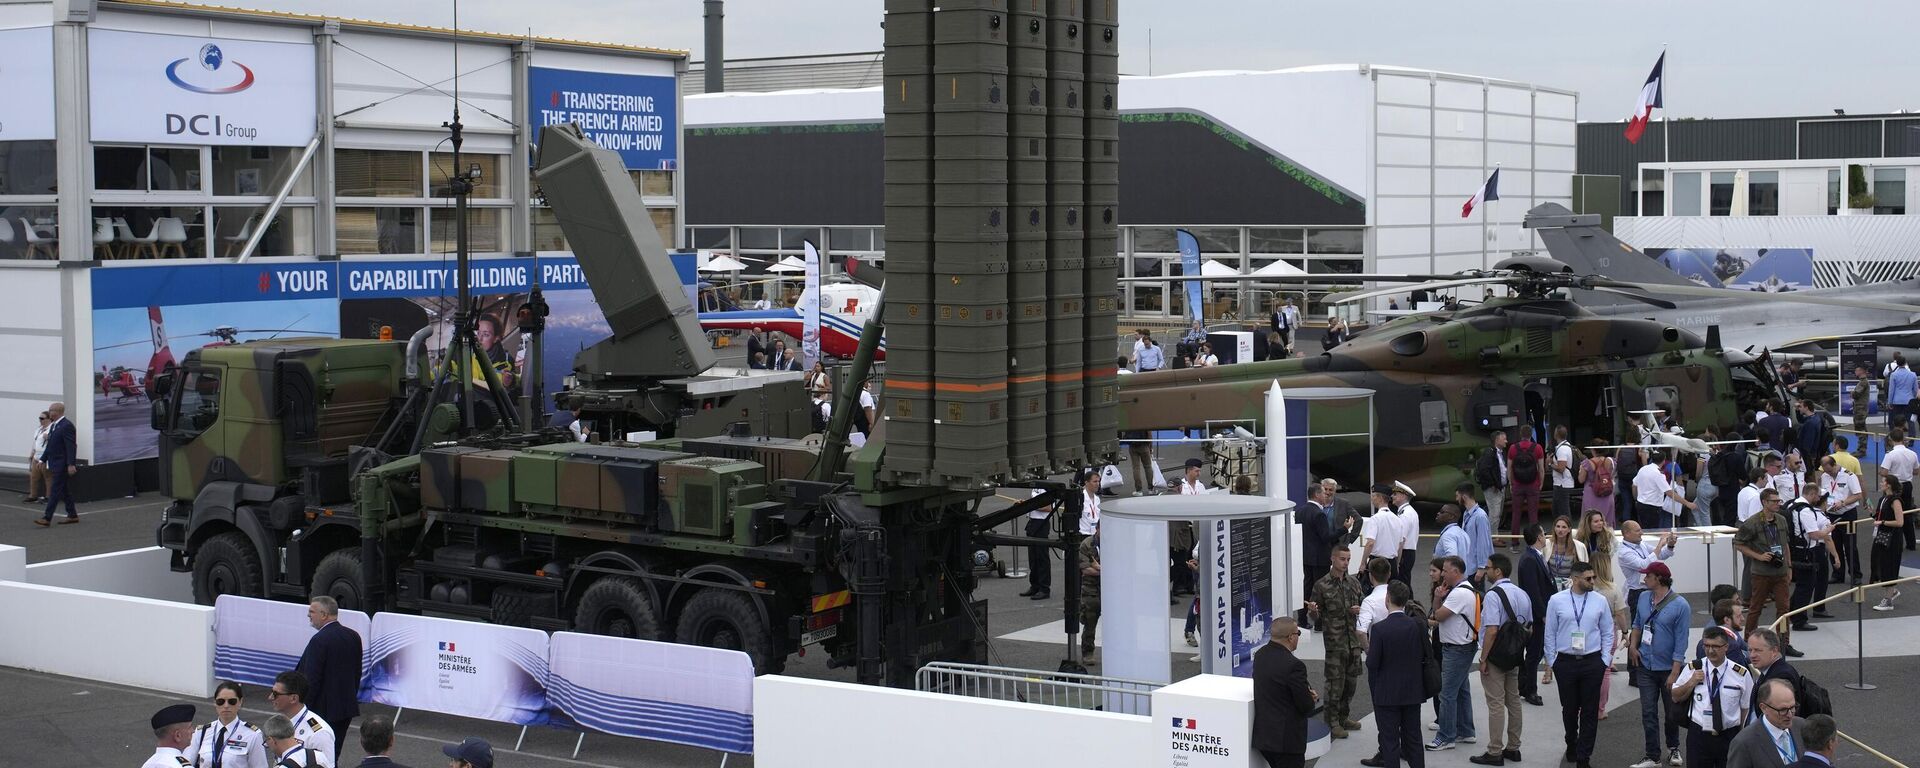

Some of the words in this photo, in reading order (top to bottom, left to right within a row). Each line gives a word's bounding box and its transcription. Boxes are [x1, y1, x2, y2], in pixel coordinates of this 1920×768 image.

[562, 91, 654, 113] TRANSFERRING
[166, 113, 221, 136] DCI
[225, 123, 257, 141] Group
[570, 111, 618, 131] FRENCH
[621, 115, 663, 132] ARMED
[595, 132, 663, 151] KNOW-HOW
[276, 270, 329, 293] YOUR
[350, 269, 449, 291] CAPABILITY
[1676, 312, 1720, 326] MARINE
[1218, 596, 1226, 659] SAMP
[439, 654, 471, 664] MINISTÈRE
[439, 662, 450, 670] DES
[451, 664, 477, 674] ARMÉES
[1172, 731, 1222, 745] MINISTÈRE
[1172, 742, 1190, 751] DES
[1192, 744, 1229, 756] ARMÉES
